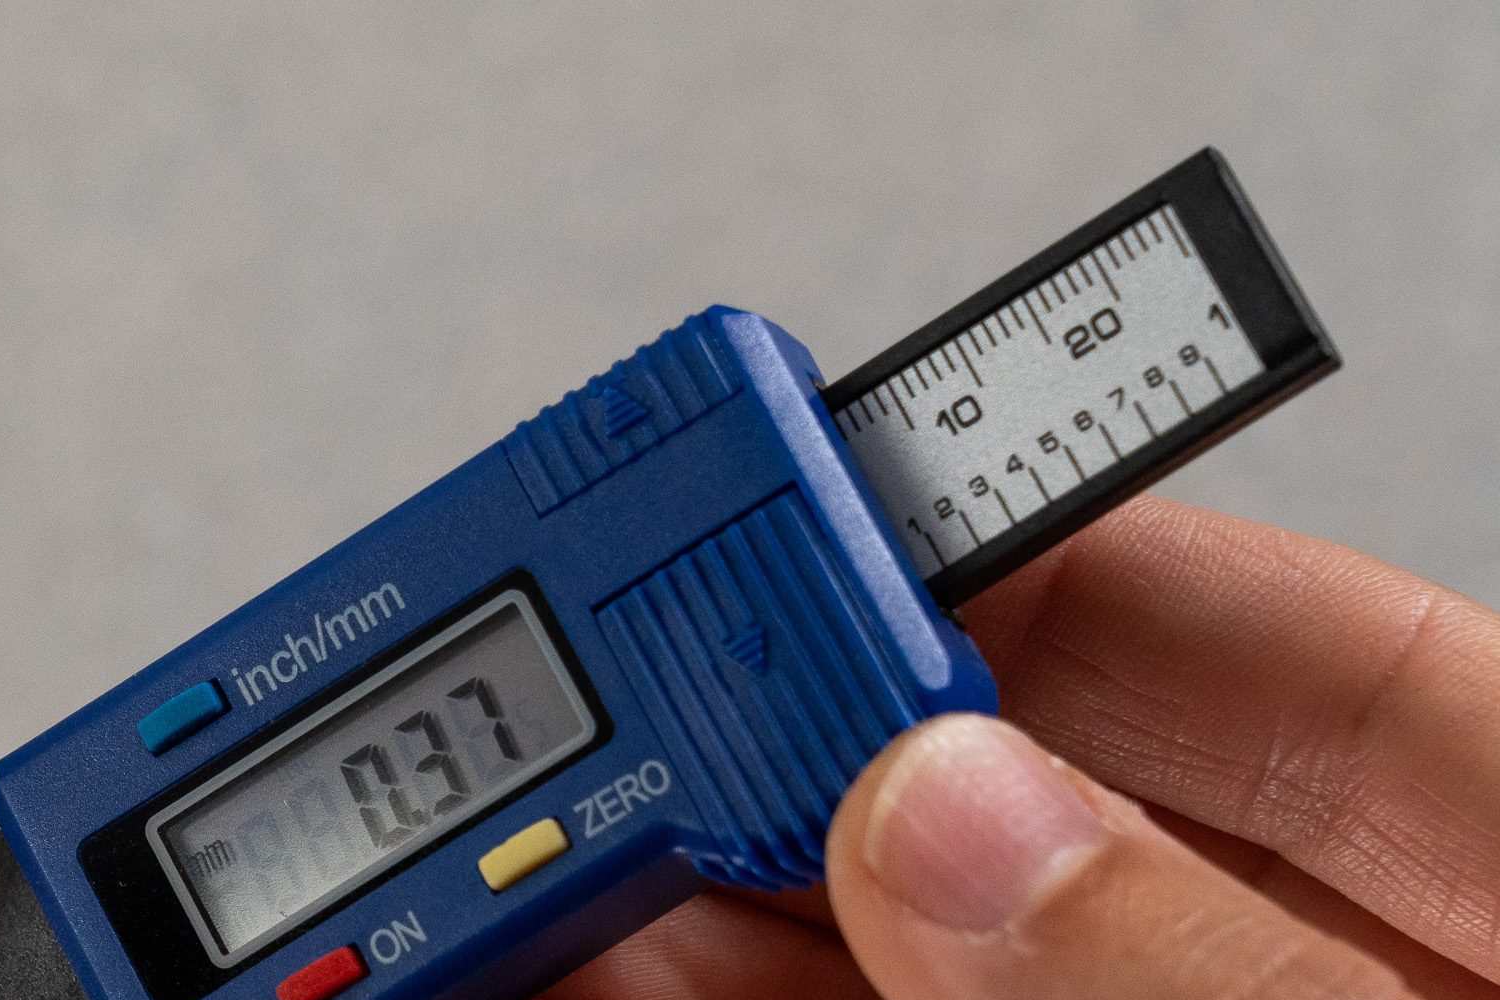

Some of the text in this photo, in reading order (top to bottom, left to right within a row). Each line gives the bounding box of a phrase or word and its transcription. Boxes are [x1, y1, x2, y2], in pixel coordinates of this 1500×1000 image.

[907, 302, 1233, 535] 1 2 3 4 5 6 7 8 9 1
[935, 306, 1124, 437] 10 20
[230, 582, 407, 707] inch/mm
[340, 676, 524, 849] 0.37
[572, 759, 671, 839] ZERO
[369, 910, 428, 965] ON
